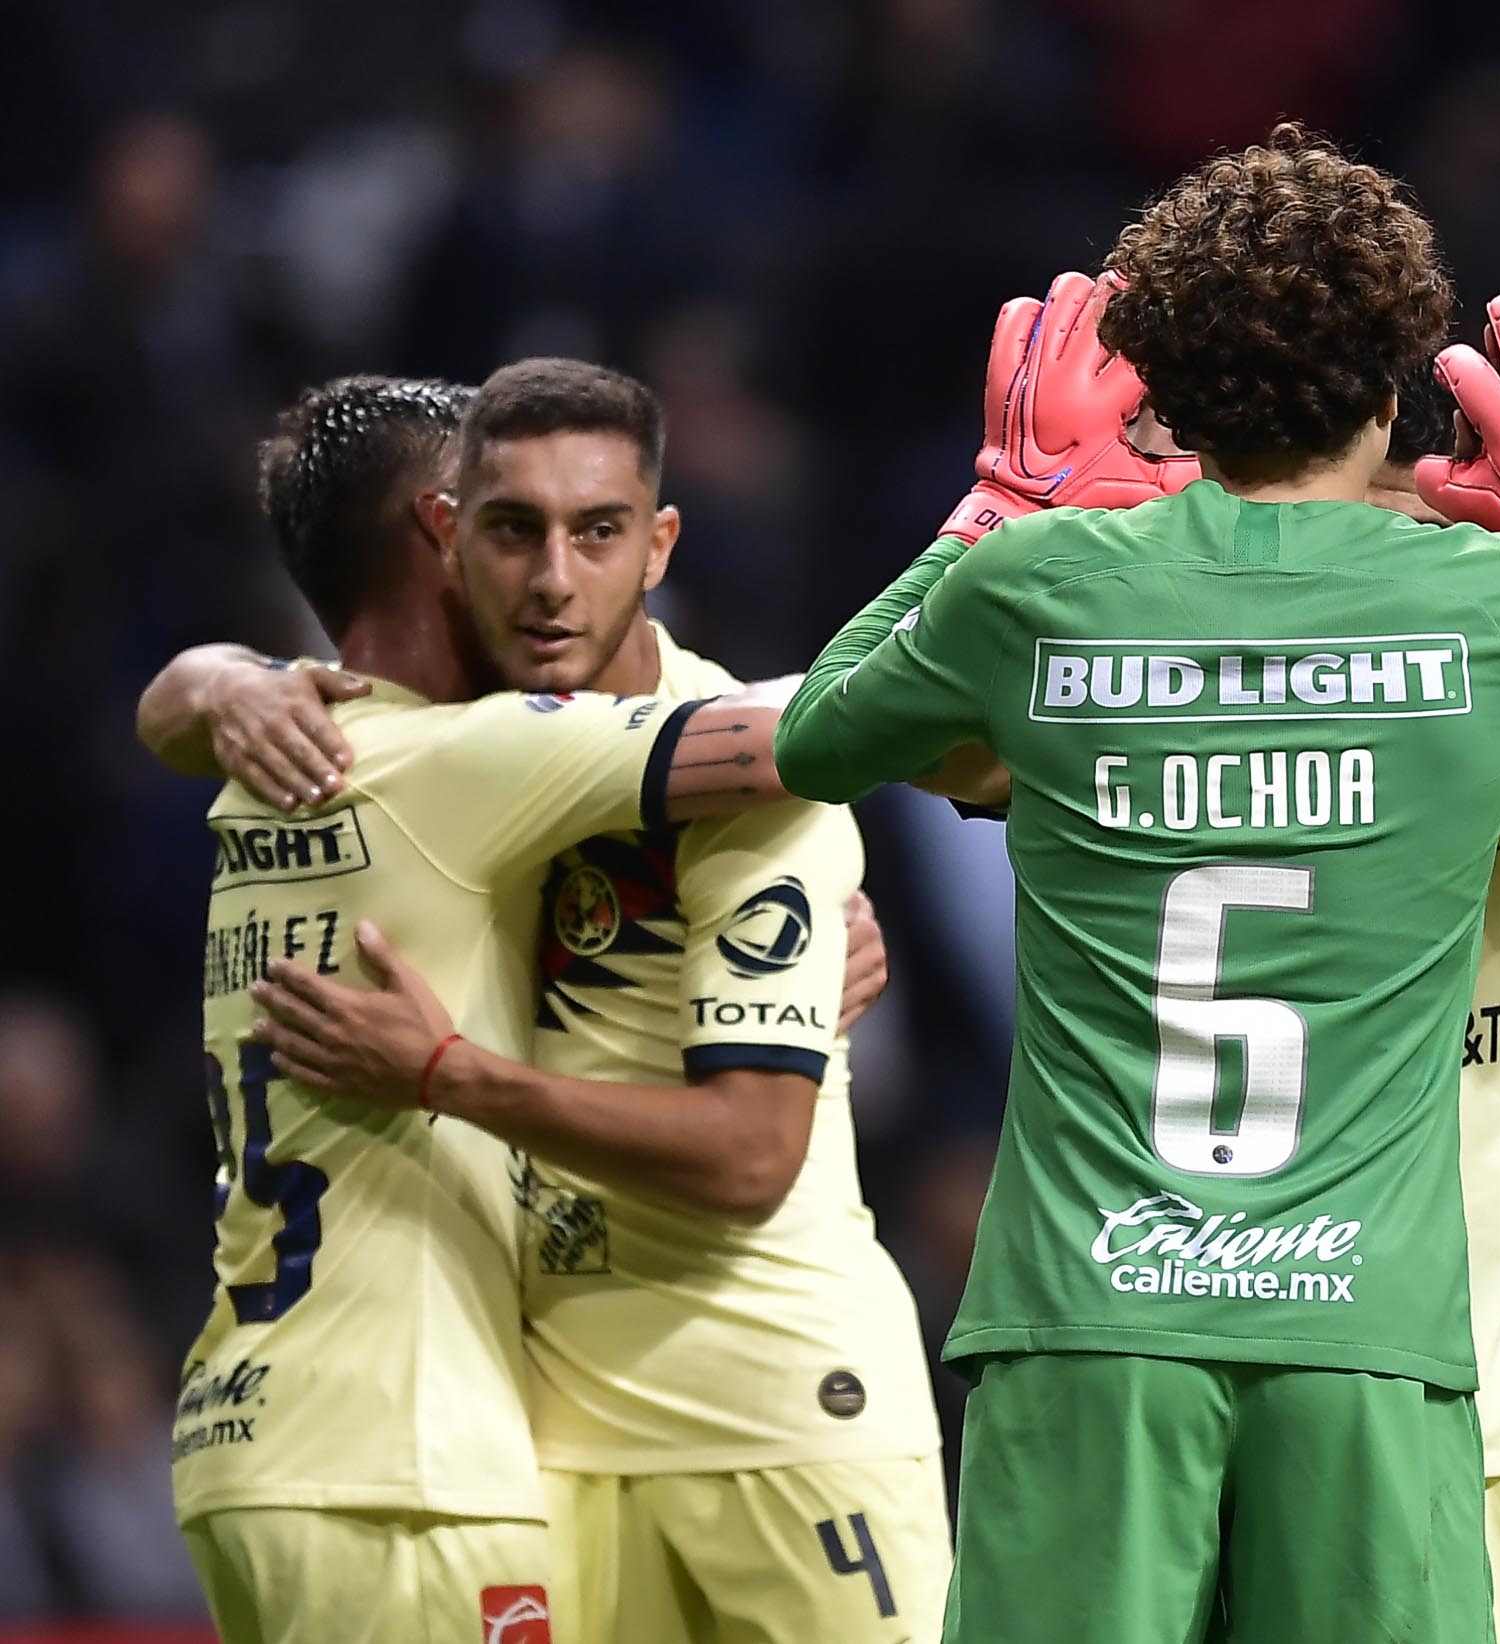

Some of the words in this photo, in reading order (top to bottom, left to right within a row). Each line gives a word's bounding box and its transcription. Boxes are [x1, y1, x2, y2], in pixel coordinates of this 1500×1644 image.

[1044, 655, 1204, 708] BUD
[1219, 649, 1452, 705] LIGHT
[206, 909, 340, 997] ONZÁLEZ
[690, 997, 826, 1030] TOTAL
[1150, 863, 1315, 1180] 6
[1091, 1190, 1362, 1270] Caliente
[1111, 1259, 1354, 1302] caliente.mx
[815, 1512, 898, 1619] 4
